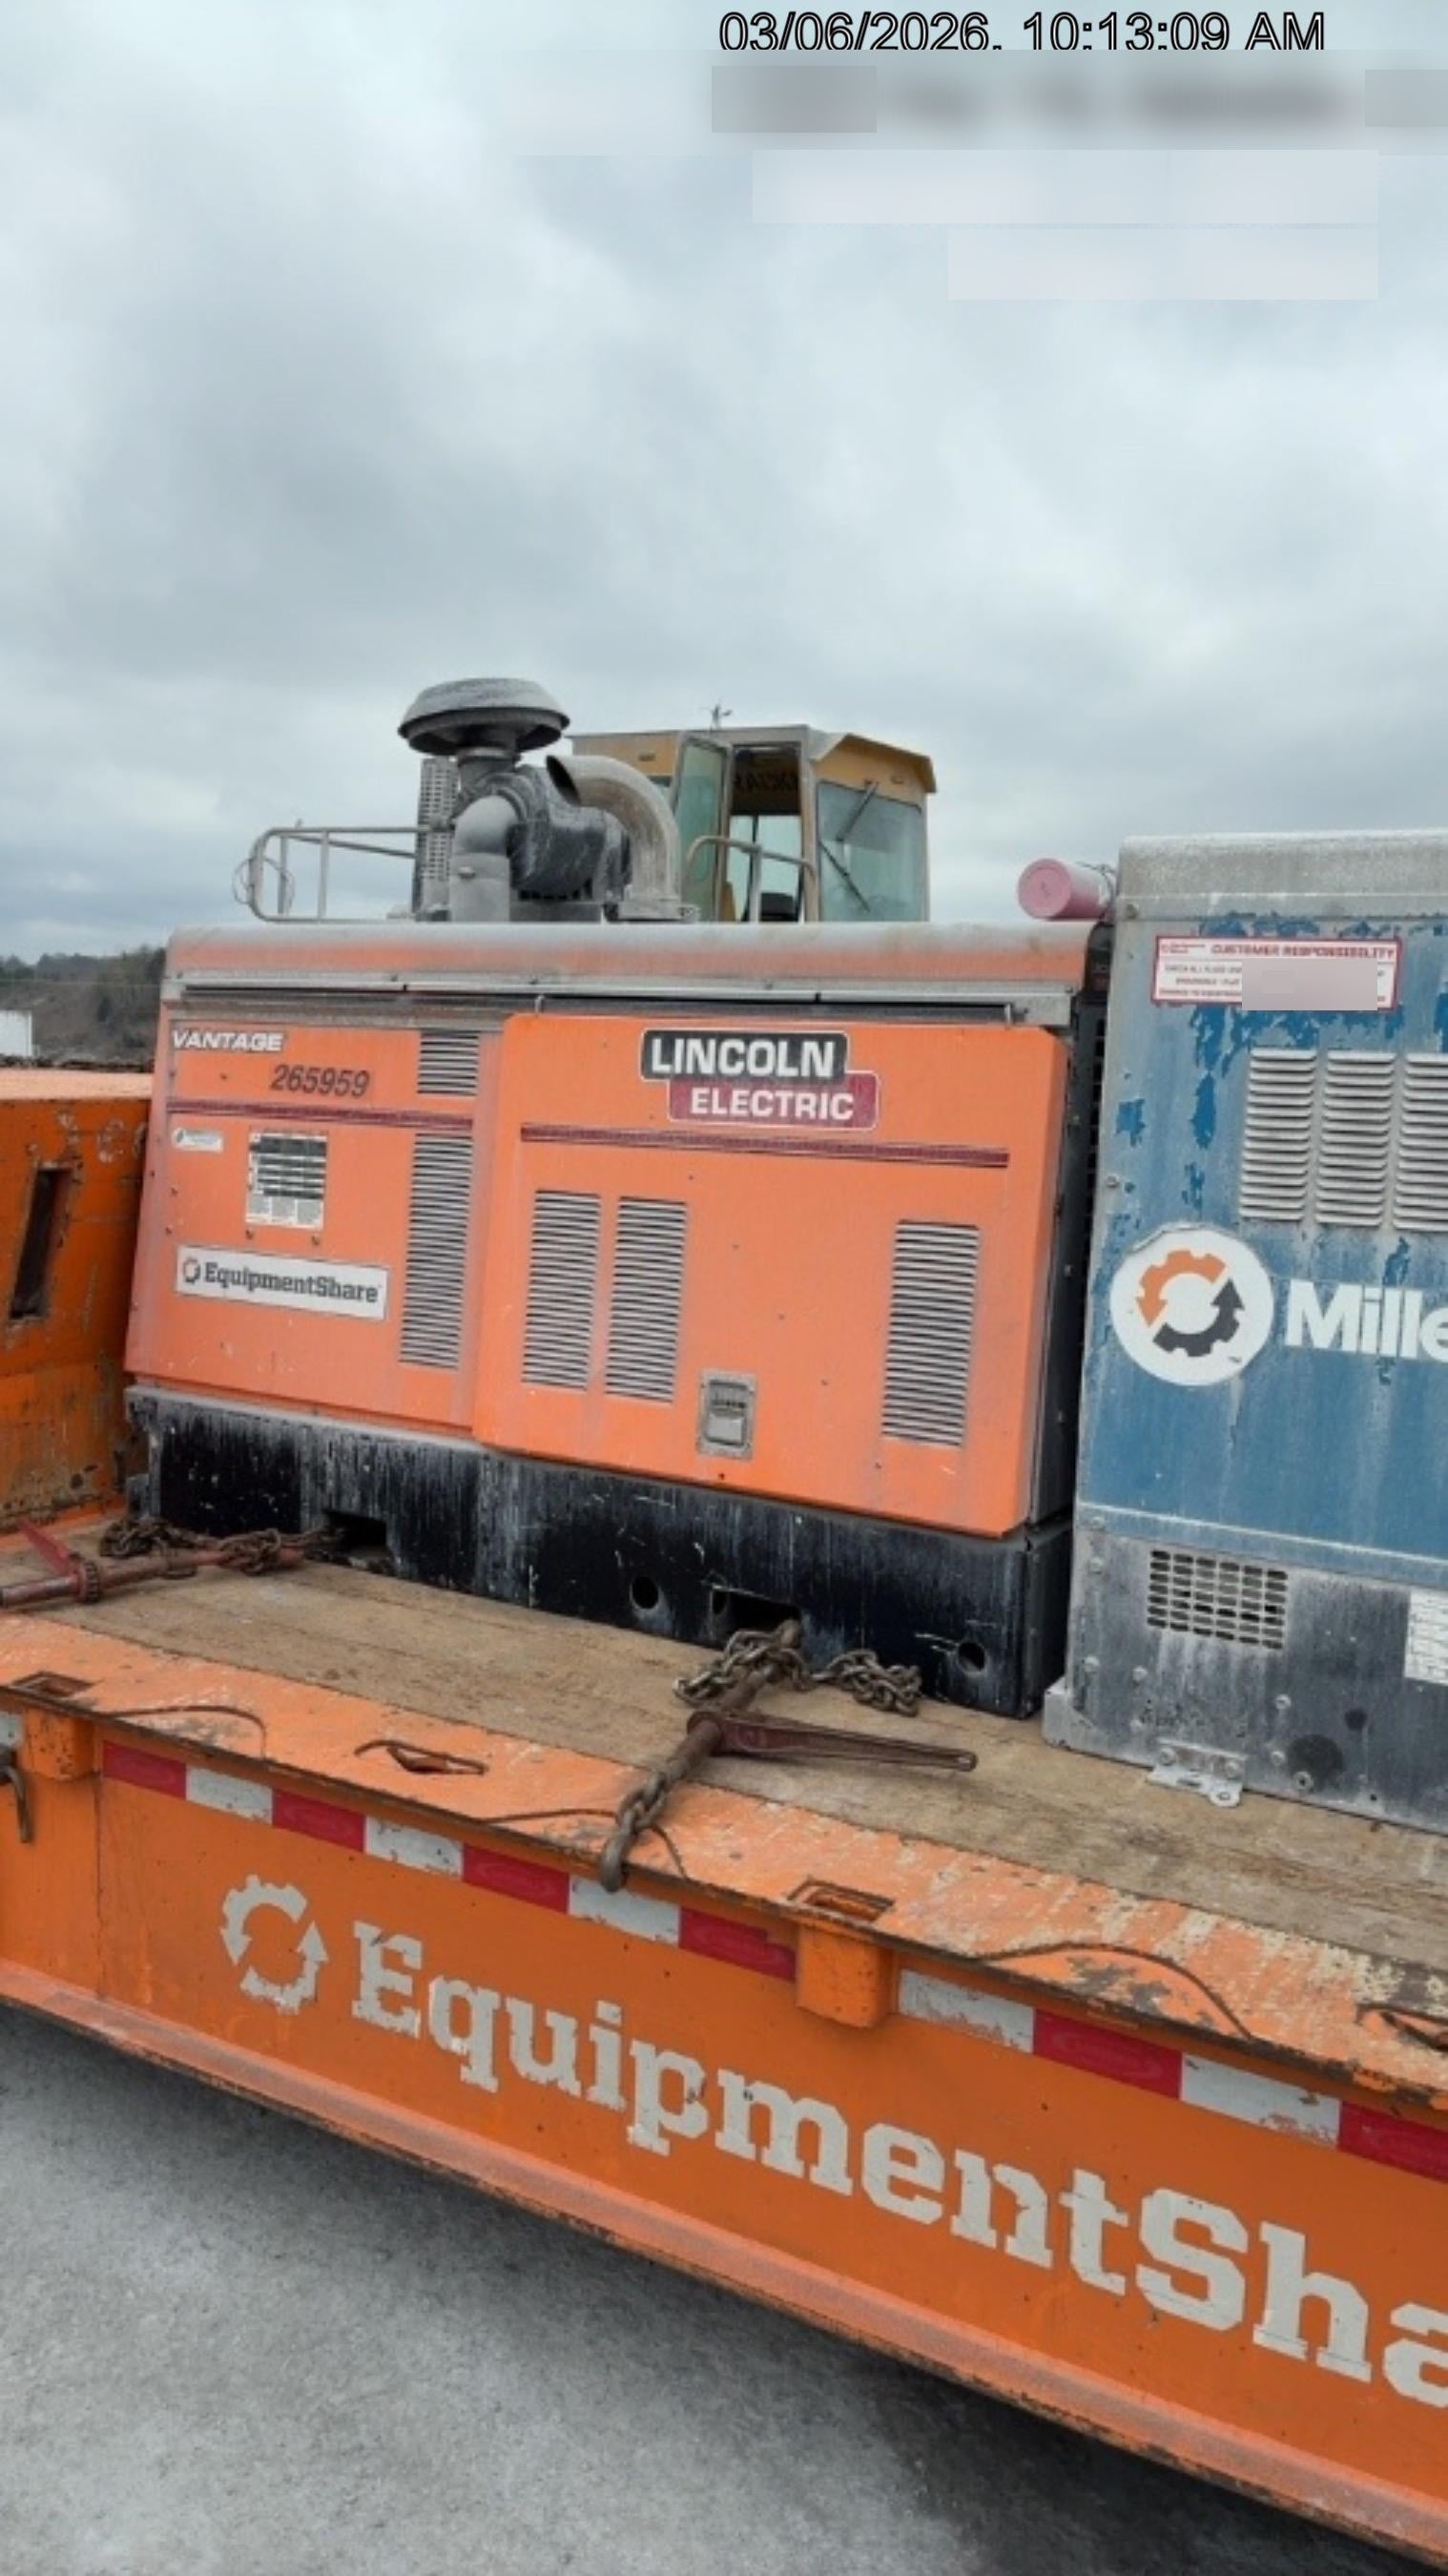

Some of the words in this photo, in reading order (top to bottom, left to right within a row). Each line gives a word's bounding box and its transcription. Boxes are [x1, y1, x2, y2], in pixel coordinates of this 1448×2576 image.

[172, 1030, 283, 1050] VANTAGE
[651, 1037, 836, 1077] LINCOLN
[271, 1064, 370, 1097] 265959
[690, 1087, 855, 1120] ELECTRIC
[204, 1261, 379, 1303] EquipmentShare
